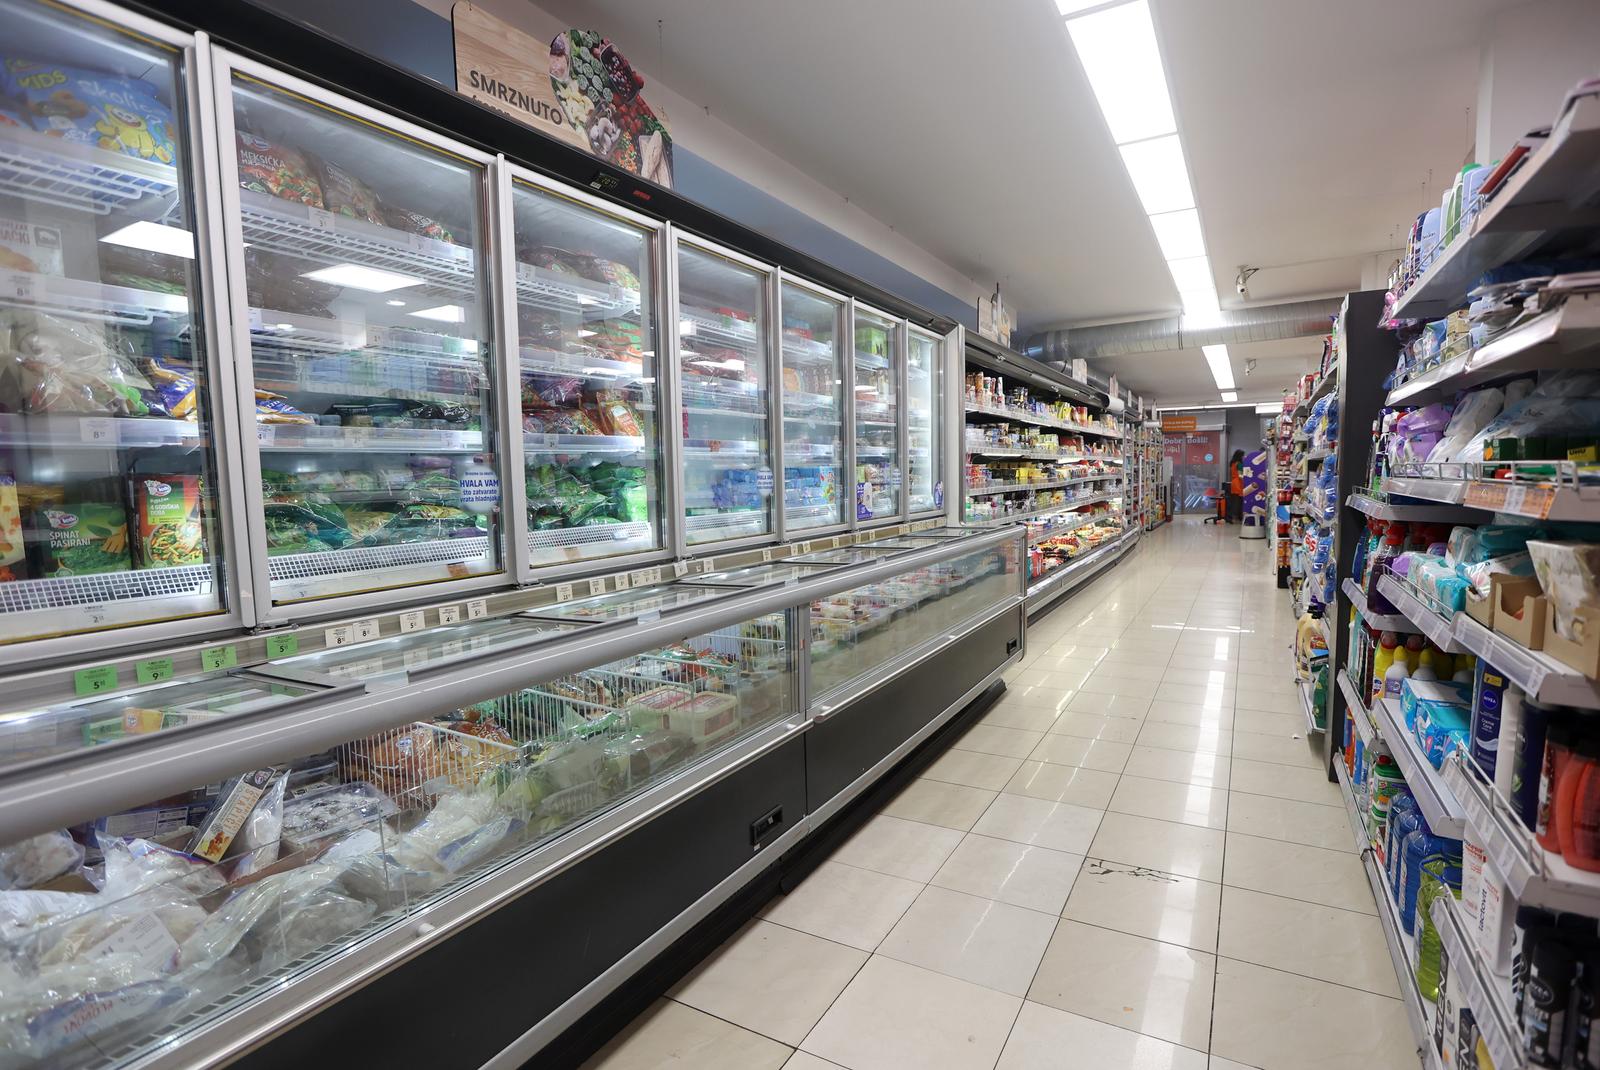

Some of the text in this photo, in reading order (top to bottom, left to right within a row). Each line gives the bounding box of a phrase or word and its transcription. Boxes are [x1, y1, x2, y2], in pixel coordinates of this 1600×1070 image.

[18, 69, 67, 88] KIDS
[470, 69, 563, 126] SMRZNUTO
[460, 479, 499, 488] HVALA VAM
[51, 538, 91, 549] PASIRANI
[1483, 695, 1497, 704] NIVEA
[1478, 888, 1488, 932] lactovit
